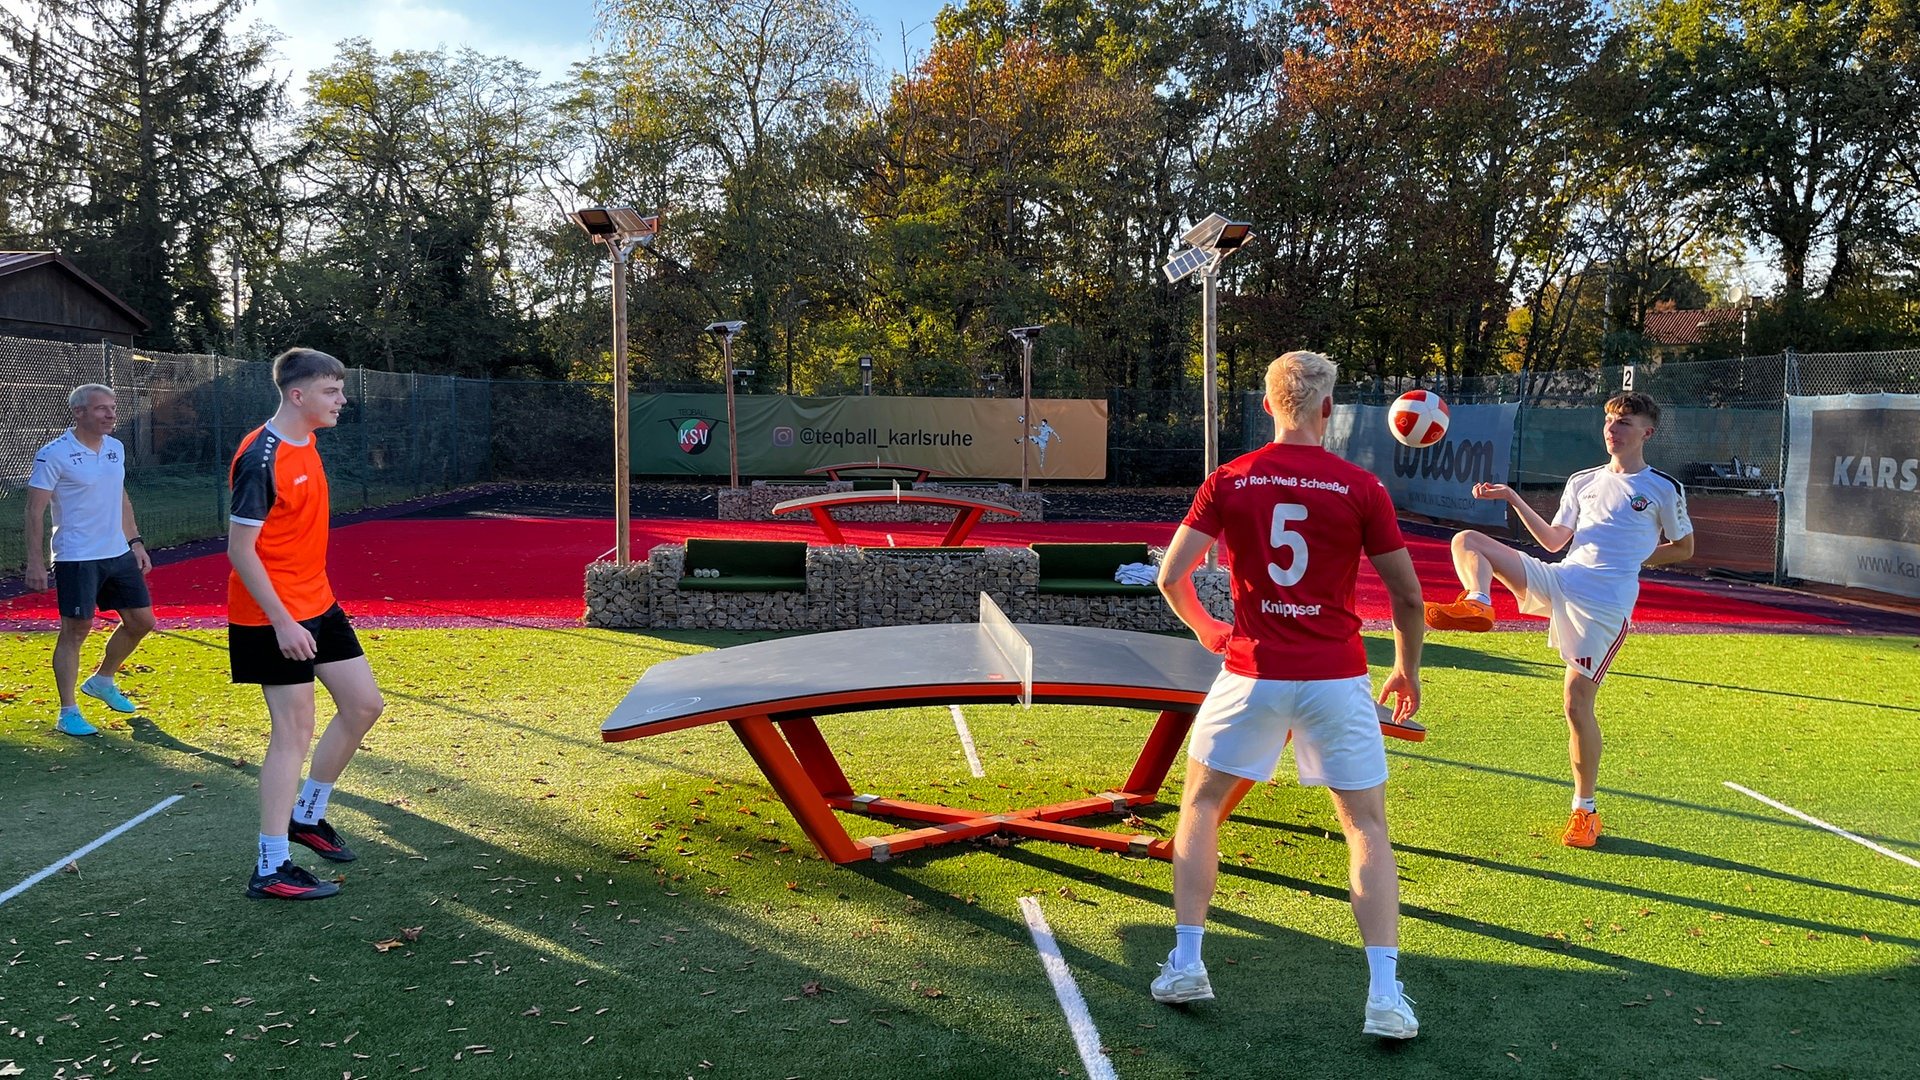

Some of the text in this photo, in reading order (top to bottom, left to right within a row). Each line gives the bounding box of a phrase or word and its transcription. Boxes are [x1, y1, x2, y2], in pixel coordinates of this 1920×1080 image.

[1624, 370, 1632, 387] 2
[680, 428, 708, 445] KSV
[800, 427, 973, 448] @teqball_karlsruhe
[1832, 455, 1919, 492] KARS
[1235, 478, 1248, 489] SV
[1250, 476, 1298, 487] Rot-Weiß
[1267, 503, 1309, 587] 5
[1261, 600, 1321, 617] Knippser
